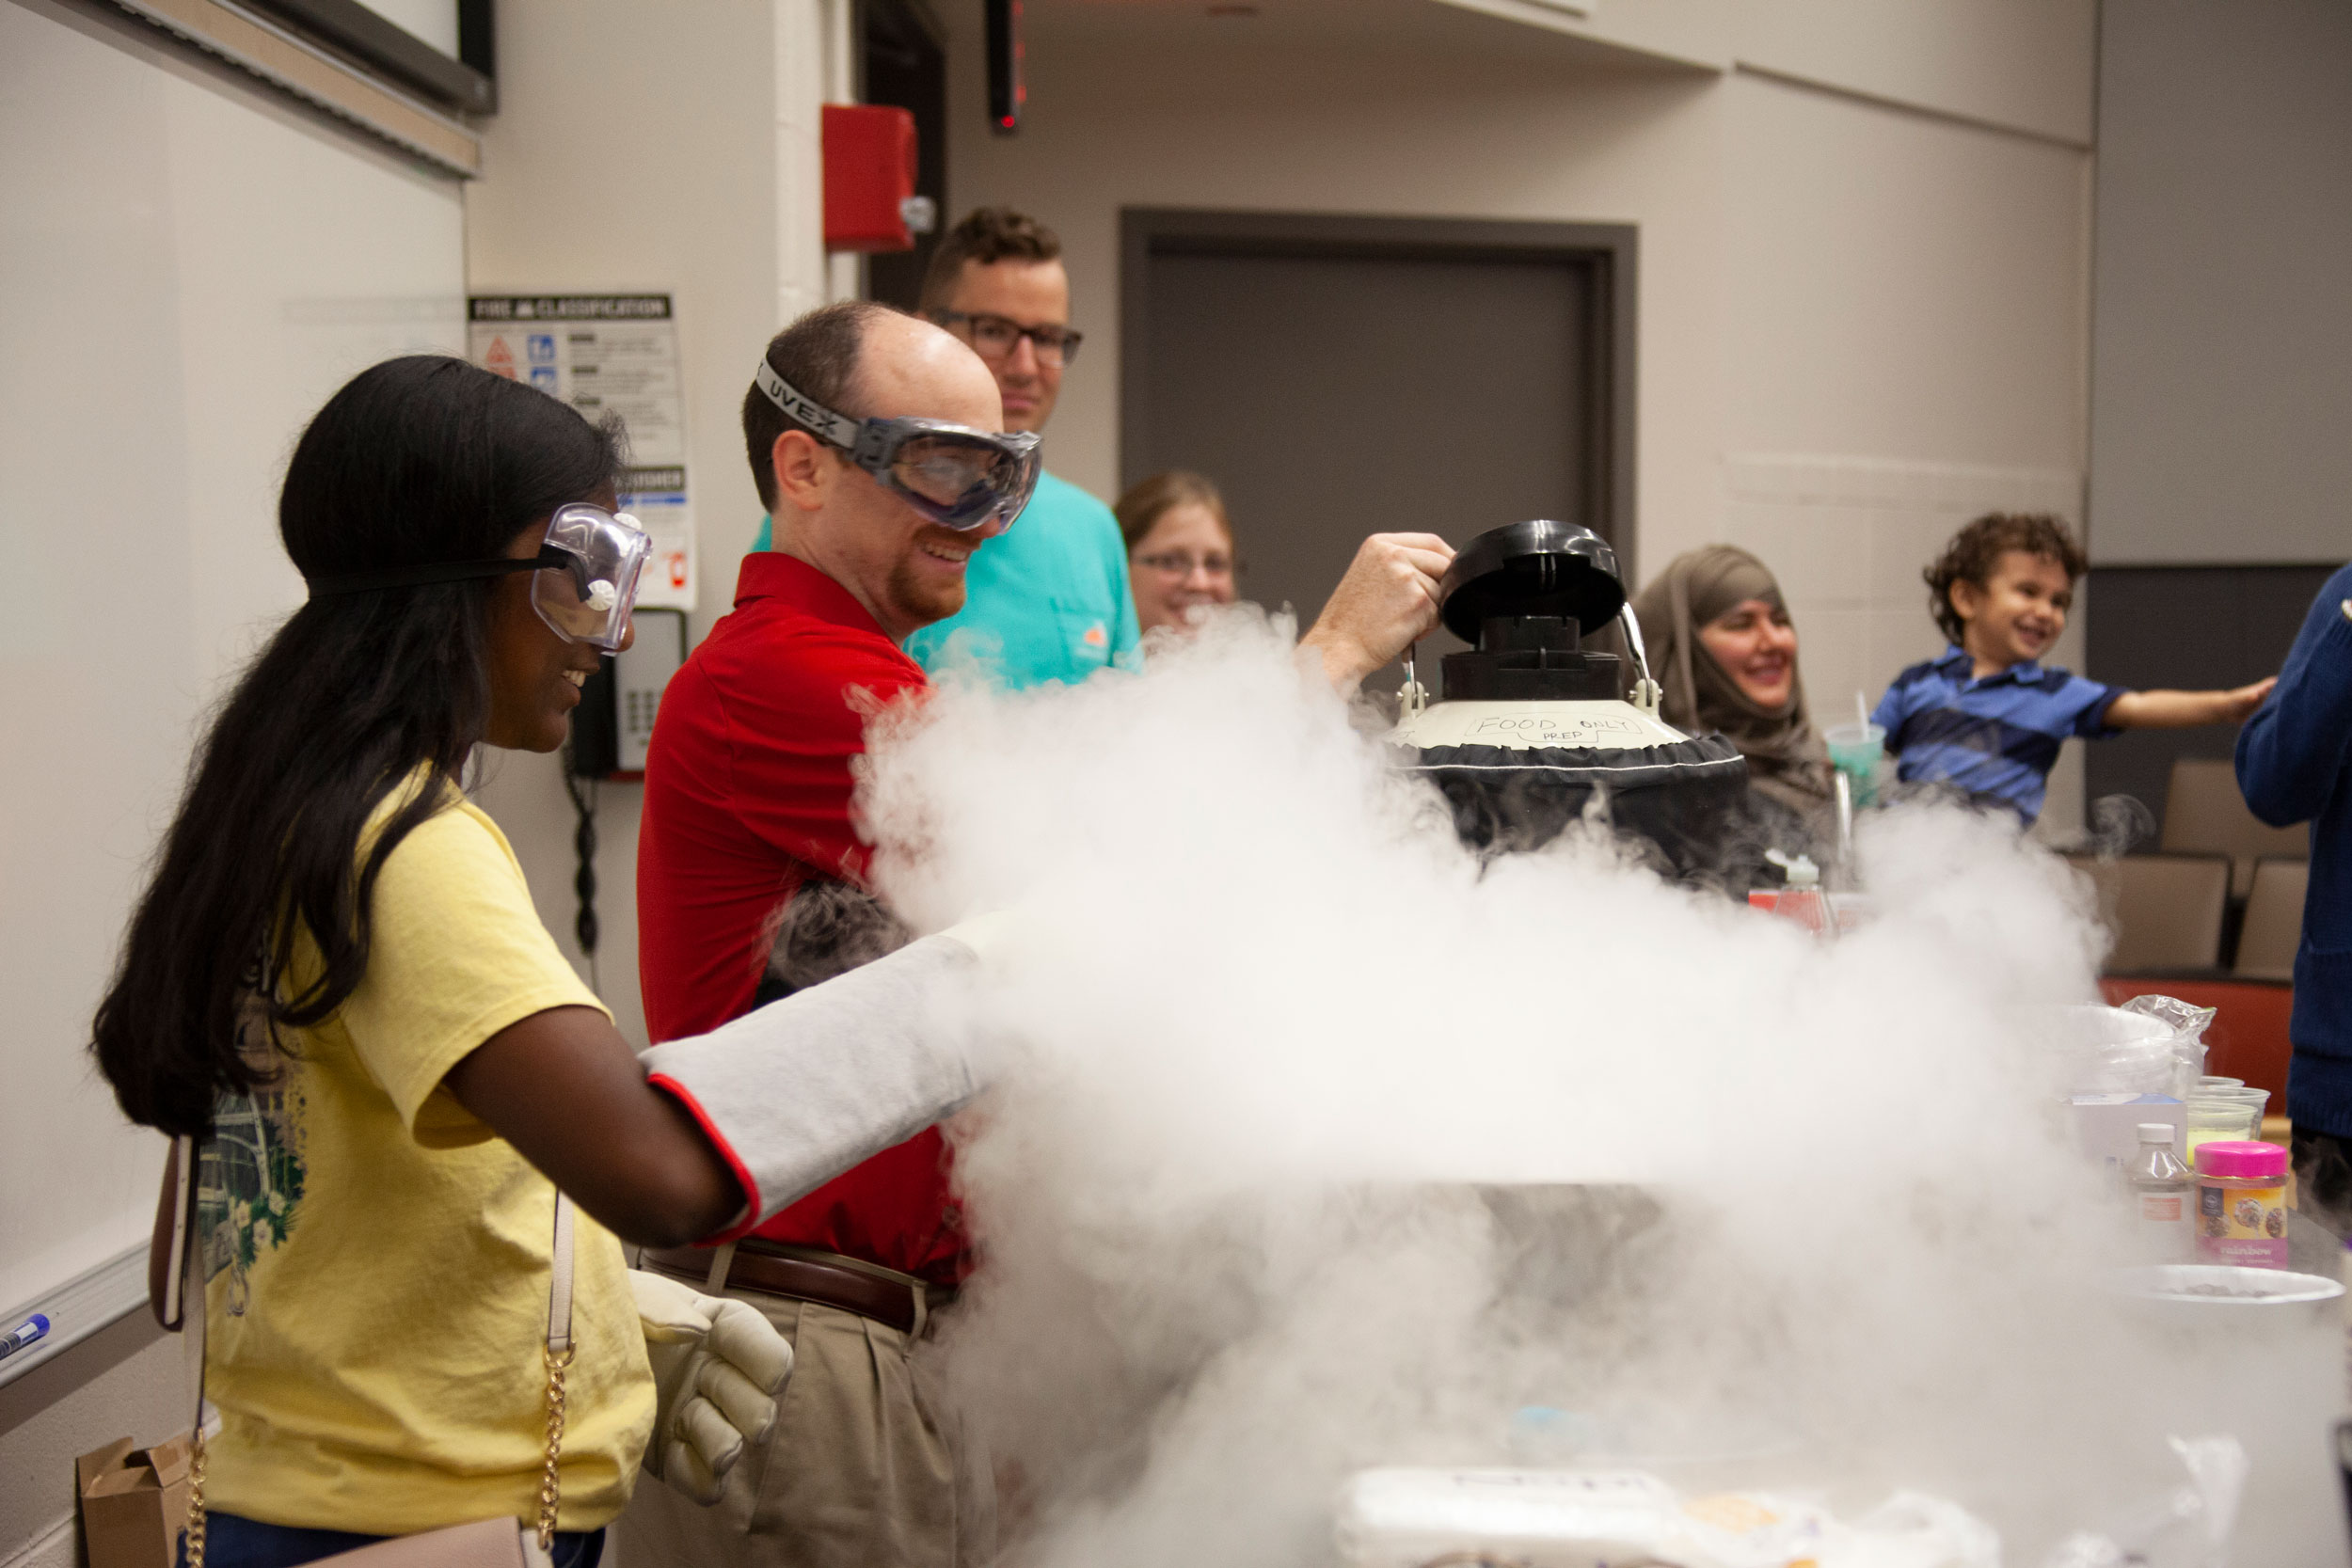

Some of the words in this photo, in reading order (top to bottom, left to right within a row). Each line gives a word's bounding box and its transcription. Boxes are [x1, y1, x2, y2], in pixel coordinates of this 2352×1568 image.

[771, 380, 838, 435] UVEX
[1476, 718, 1557, 733] FOOD
[1580, 720, 1630, 731] ONLY
[1543, 731, 1583, 741] PREP
